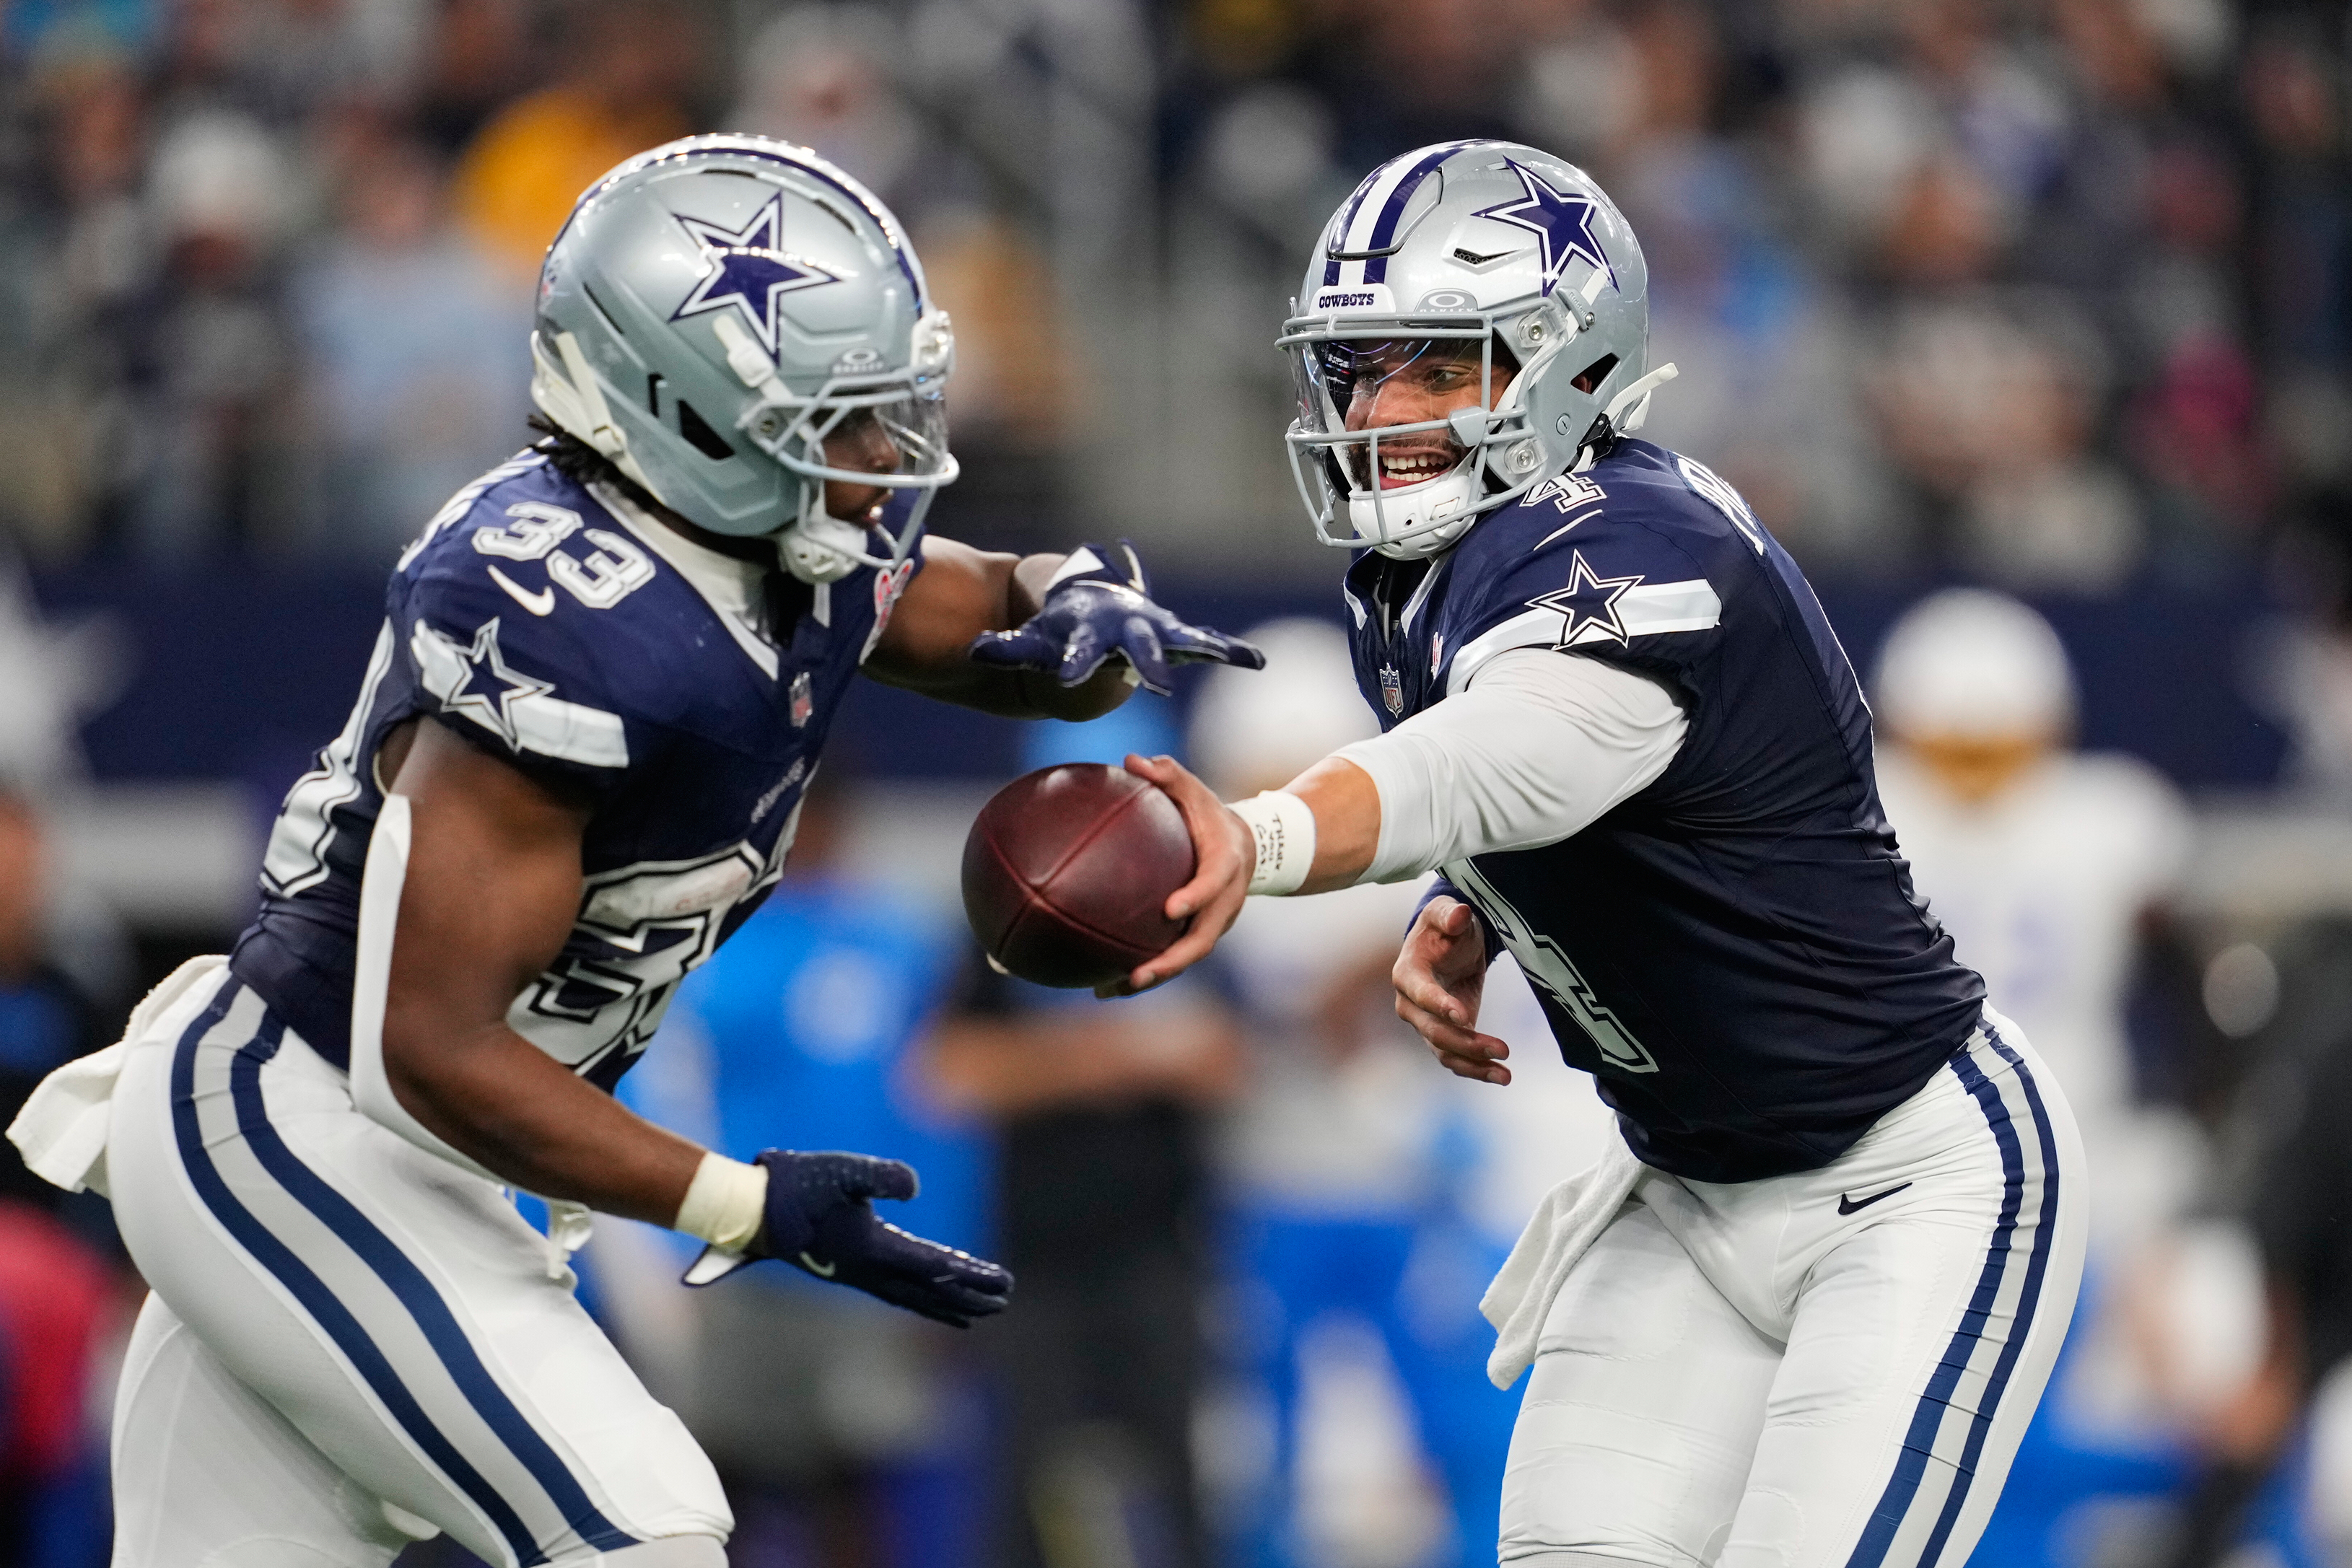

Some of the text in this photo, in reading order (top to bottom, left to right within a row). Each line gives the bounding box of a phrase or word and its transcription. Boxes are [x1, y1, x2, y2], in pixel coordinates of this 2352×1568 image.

[1319, 293, 1375, 309] COWBOYS
[1518, 472, 1608, 514] 4
[471, 501, 656, 605] 33
[1386, 688, 1402, 707] NFL
